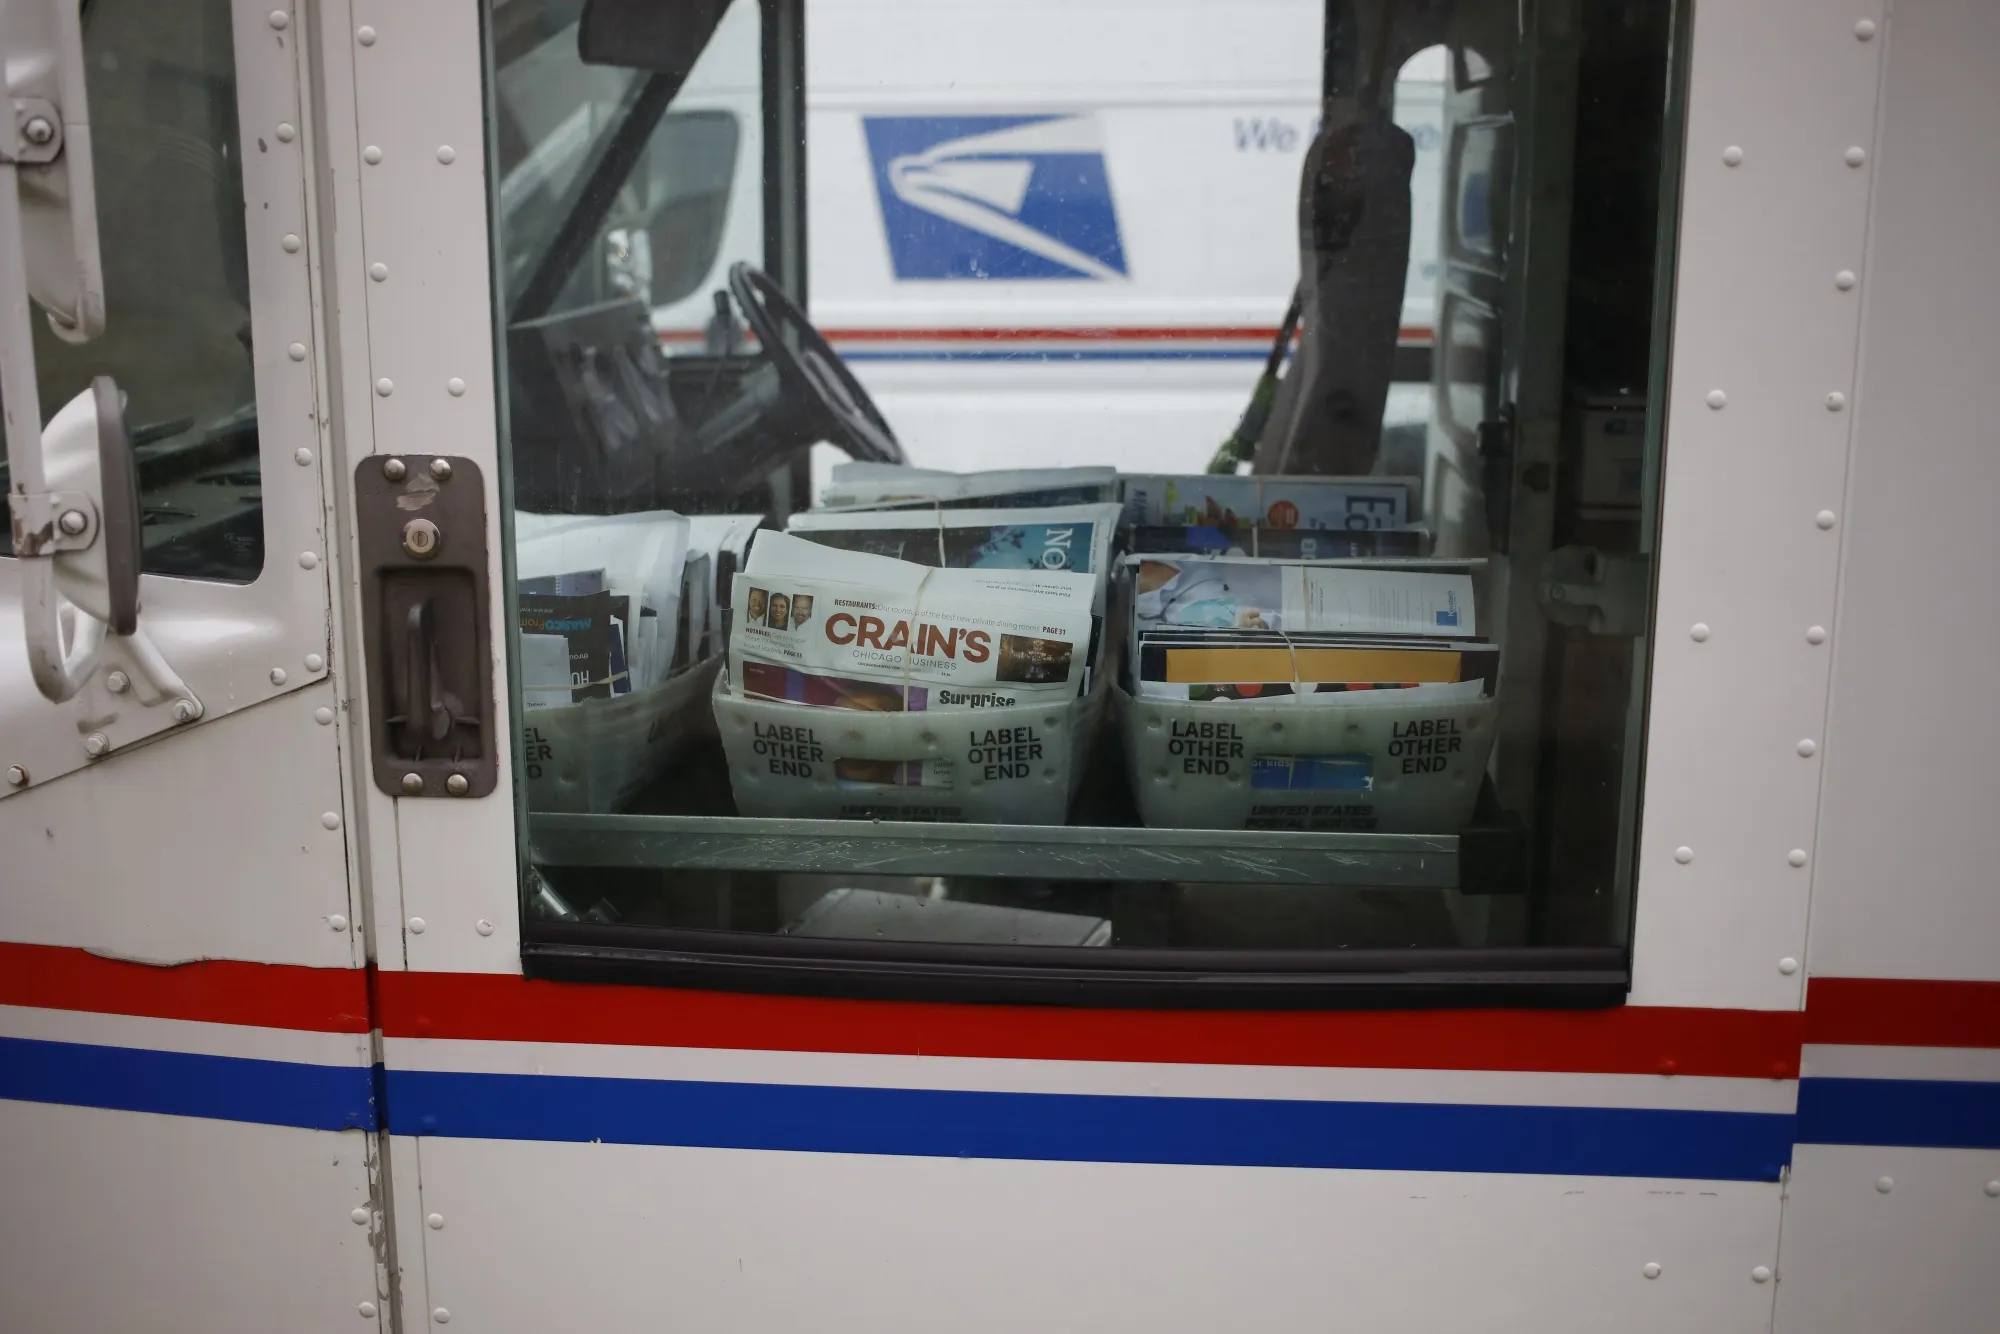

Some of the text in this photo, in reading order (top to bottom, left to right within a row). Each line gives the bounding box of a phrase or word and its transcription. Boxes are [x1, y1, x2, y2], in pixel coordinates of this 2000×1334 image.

[1232, 117, 1298, 152] We
[834, 598, 877, 610] RESTAURANTS:
[891, 606, 920, 616] roundp
[972, 617, 995, 627] private
[1042, 626, 1058, 635] PAGE
[825, 612, 992, 663] CRAIN'S
[852, 649, 902, 663] CHICAGO
[939, 689, 1016, 708] Surprise
[753, 721, 821, 746] LABEL
[969, 726, 1041, 747] LABEL
[1171, 719, 1243, 741] LABEL
[1392, 718, 1461, 738] LABEL
[752, 740, 824, 763] OTHER
[967, 743, 1043, 765] OTHER
[1168, 738, 1244, 759] OTHER
[1387, 736, 1462, 757] OTHER
[769, 758, 813, 778] END
[983, 762, 1030, 781] END
[1183, 758, 1230, 776] END
[1401, 756, 1447, 774] END
